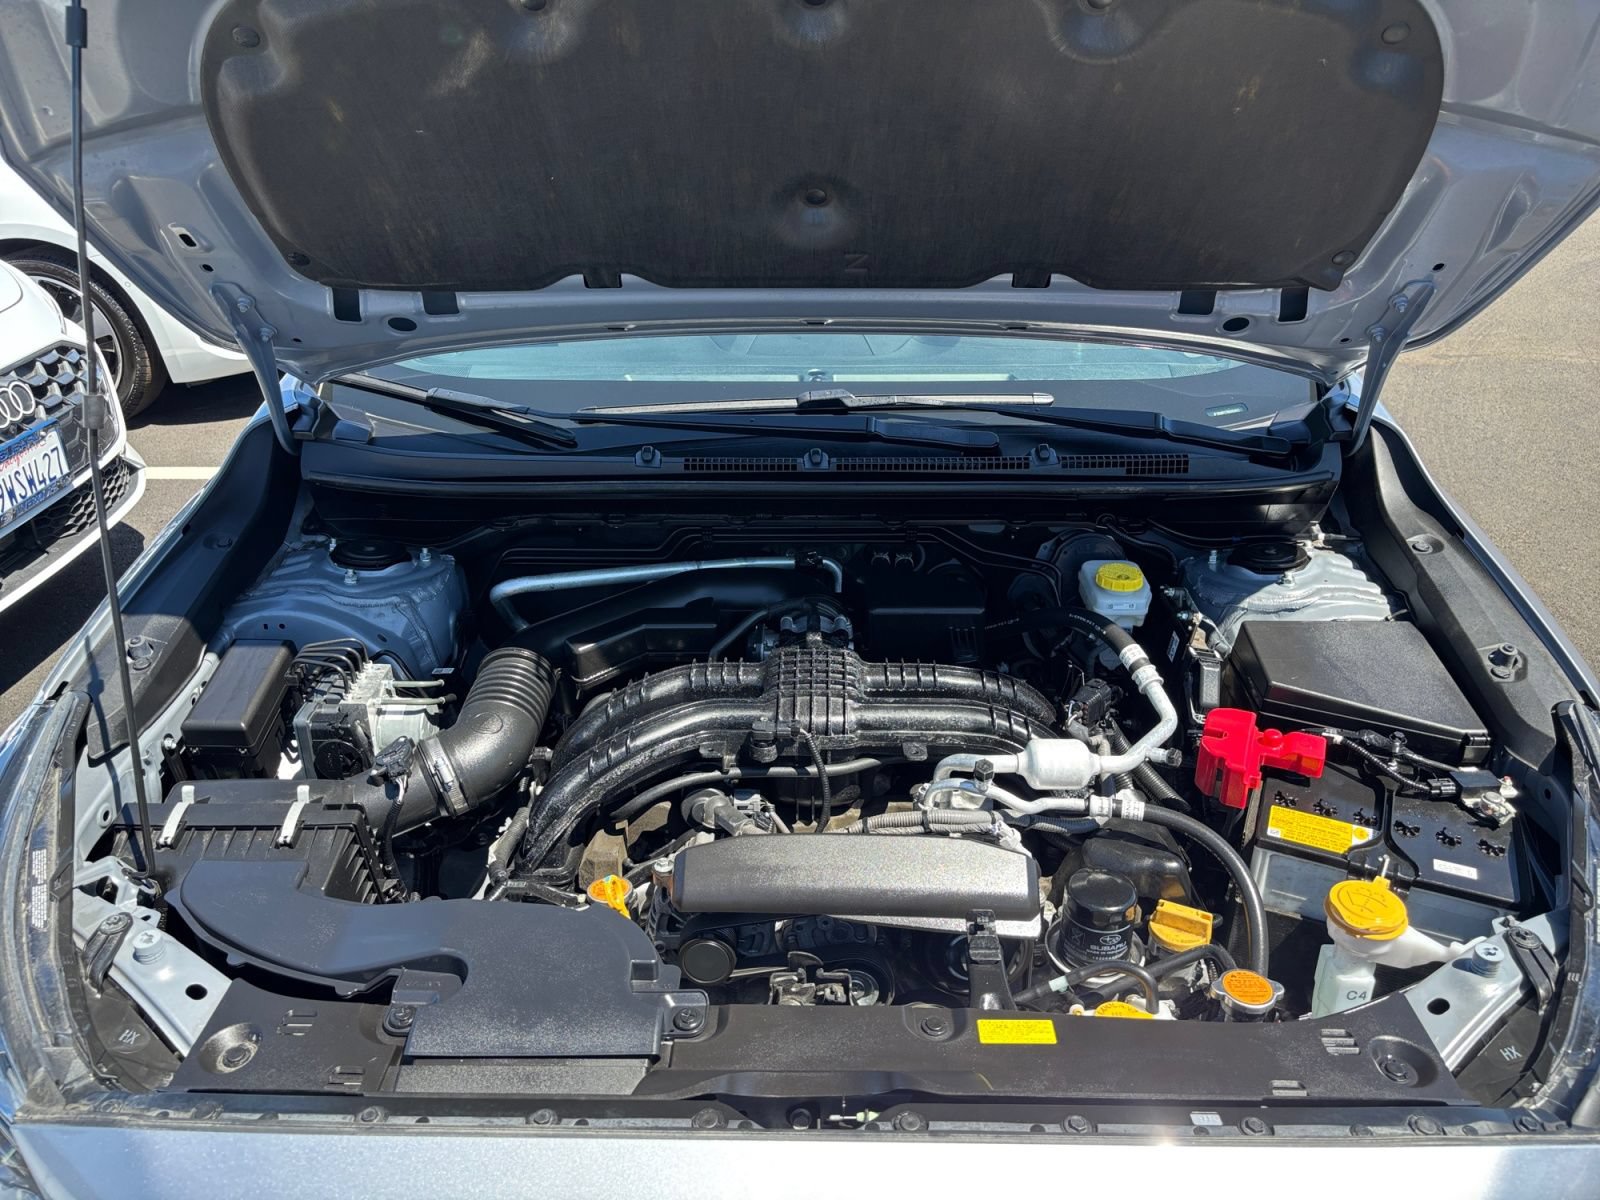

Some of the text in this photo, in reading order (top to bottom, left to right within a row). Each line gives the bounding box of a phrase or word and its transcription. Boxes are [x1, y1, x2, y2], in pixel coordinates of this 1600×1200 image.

[1090, 941, 1127, 951] SUBARU
[1346, 990, 1367, 1001] C4
[118, 1029, 141, 1045] HX
[1499, 1045, 1523, 1061] HX
